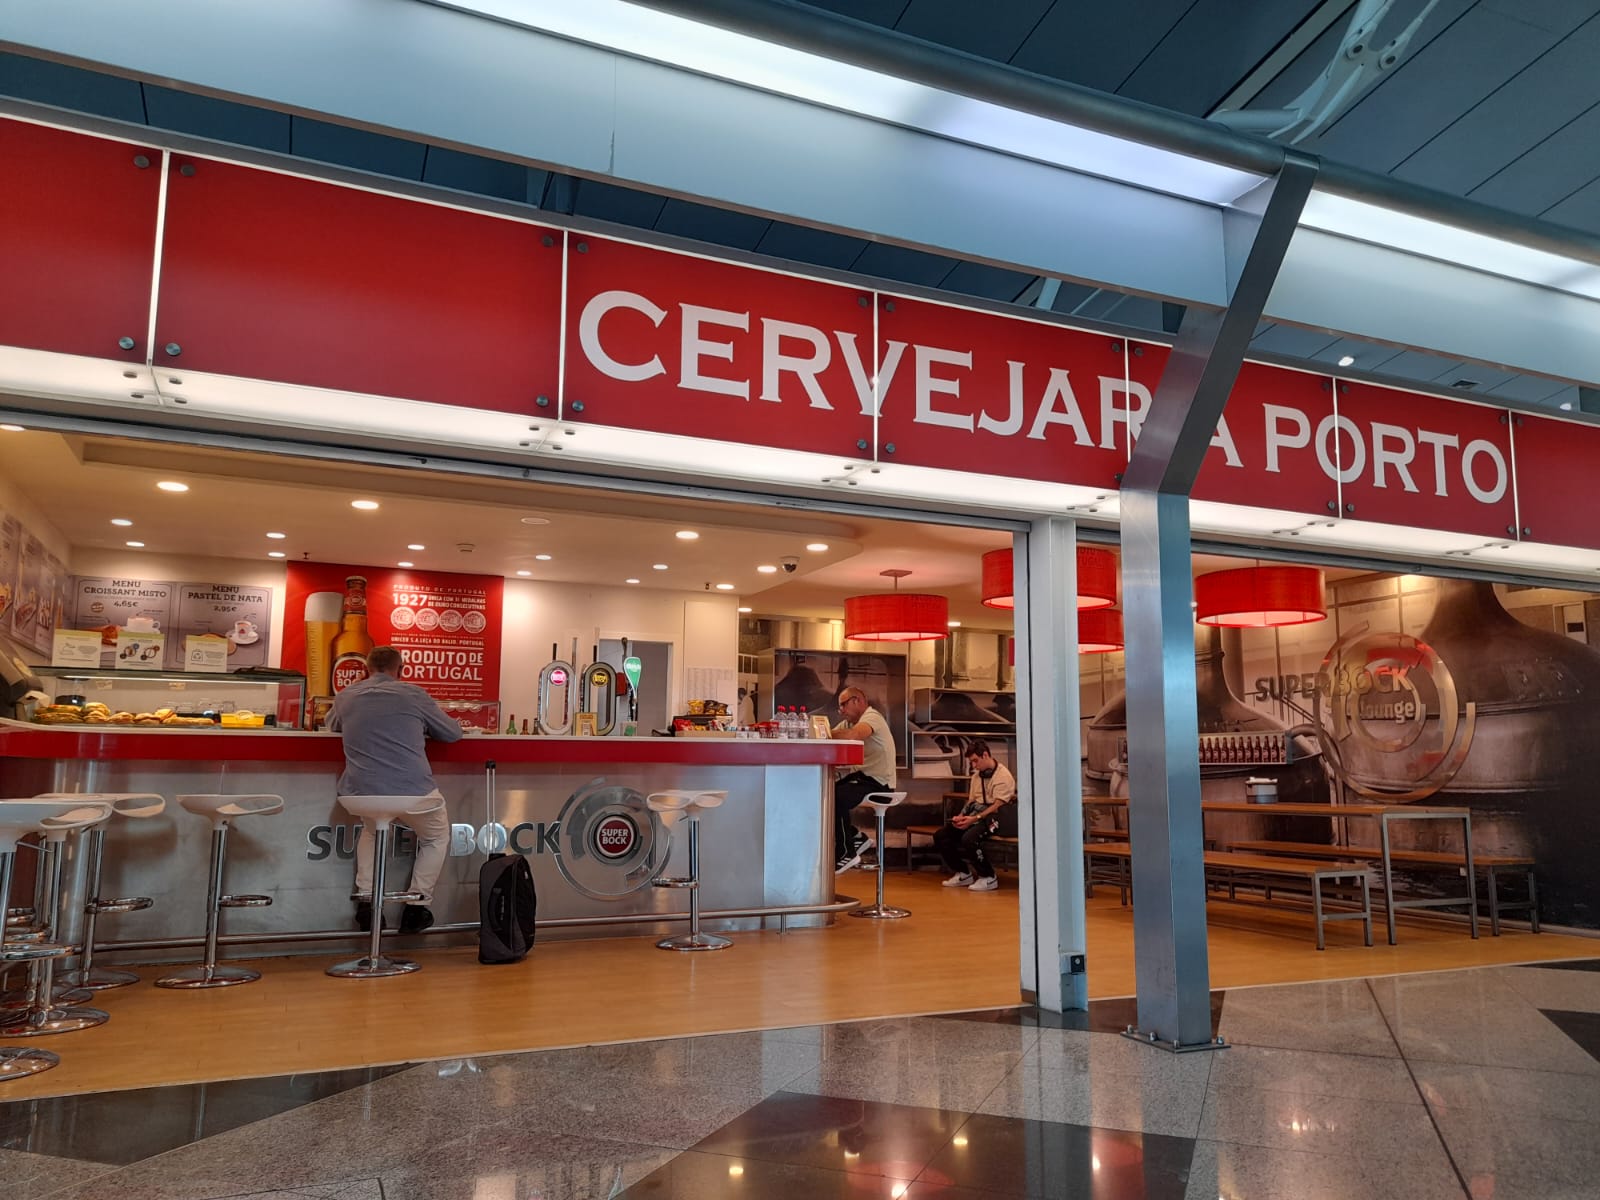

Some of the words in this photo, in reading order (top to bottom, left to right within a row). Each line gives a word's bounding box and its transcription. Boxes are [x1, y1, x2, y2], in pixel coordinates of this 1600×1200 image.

[579, 290, 1244, 468] CERVEJARA
[1262, 403, 1508, 504] PORTO
[112, 580, 141, 588] MENU
[212, 585, 240, 593] MENU
[393, 584, 430, 592] PRODUTO
[83, 586, 136, 597] CROISSANT
[138, 590, 167, 598] MISTO
[187, 591, 221, 601] PASTEL
[238, 595, 263, 603] NATA
[392, 593, 428, 606] 1927
[401, 649, 467, 666] RODUTO
[469, 652, 484, 663] DE
[401, 665, 483, 681] ORTUGAL
[1255, 672, 1332, 701] SUPER
[1333, 665, 1413, 697] BOCK
[601, 828, 629, 837] SUPER
[450, 822, 561, 857] BOCK
[602, 836, 627, 845] BOCK
